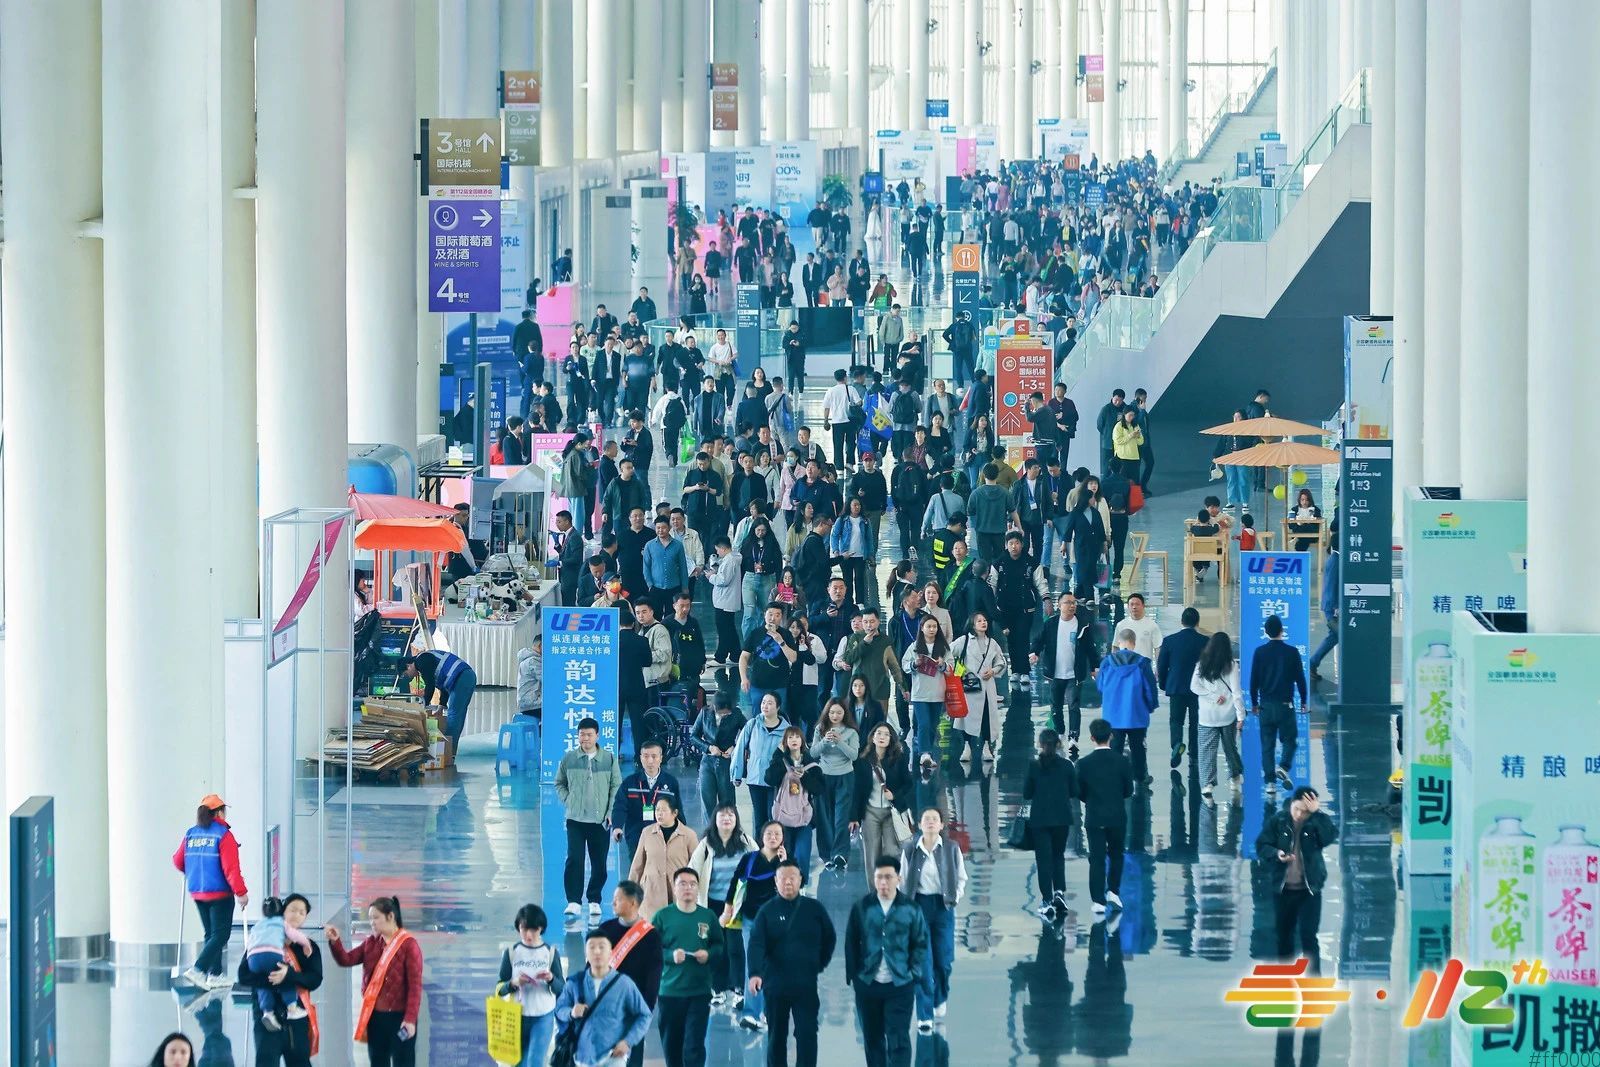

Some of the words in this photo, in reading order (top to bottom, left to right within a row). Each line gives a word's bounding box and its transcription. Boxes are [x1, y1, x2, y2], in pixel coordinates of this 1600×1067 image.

[435, 235, 493, 247] 国际葡萄酒
[435, 248, 470, 260] 及烈酒
[1350, 462, 1369, 471] 展厅
[1350, 499, 1367, 507] 入口
[1350, 516, 1358, 527] B
[1349, 599, 1368, 608] 展厅
[1348, 616, 1357, 628] 4
[551, 634, 611, 644] 纵连展会物流
[551, 646, 611, 656] 指定快递合作商
